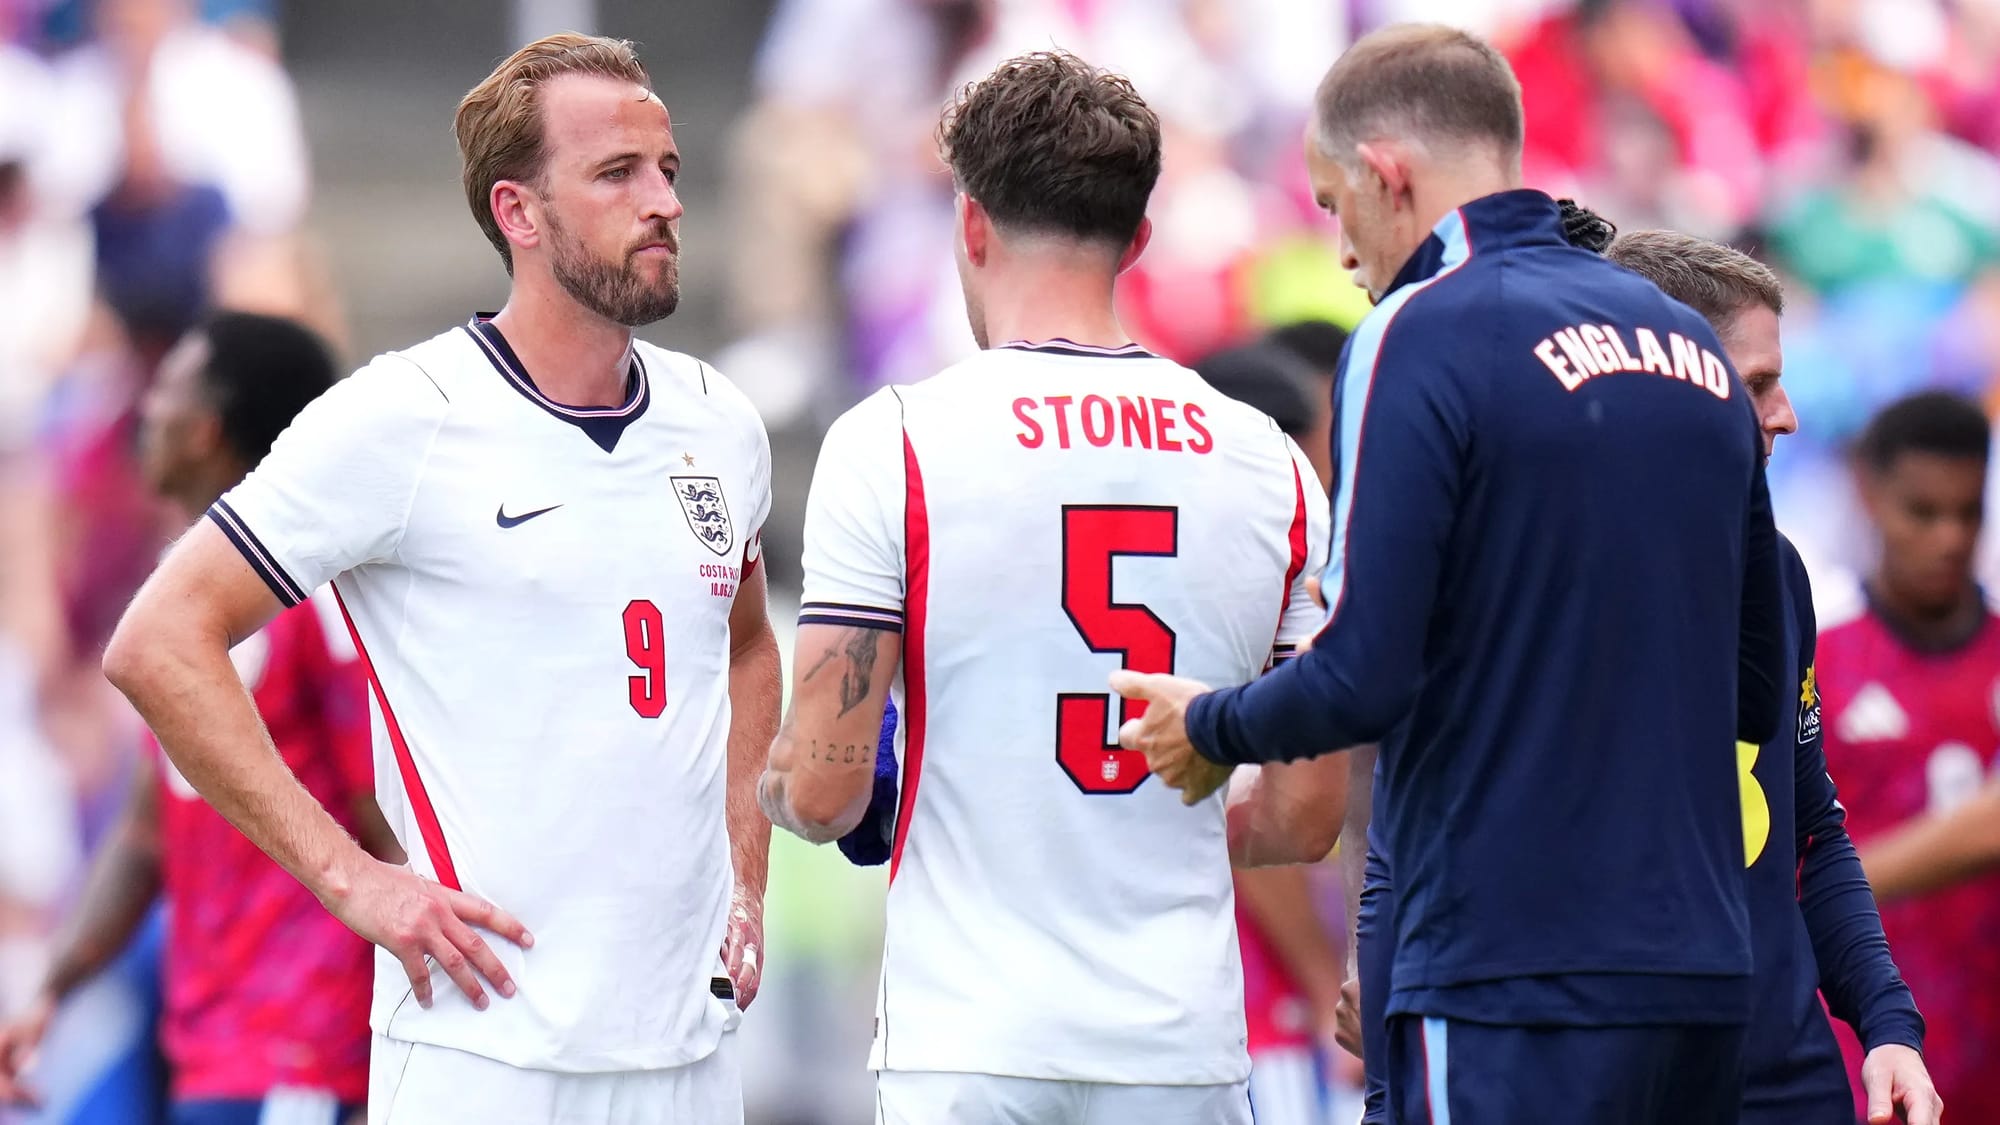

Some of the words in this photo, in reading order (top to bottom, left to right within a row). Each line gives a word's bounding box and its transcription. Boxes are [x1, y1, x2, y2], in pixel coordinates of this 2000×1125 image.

[1533, 323, 1731, 400] ENGLAND
[1011, 394, 1214, 455] STONES
[699, 564, 728, 579] COSTA
[622, 599, 668, 719] 9
[1055, 504, 1179, 795] 5
